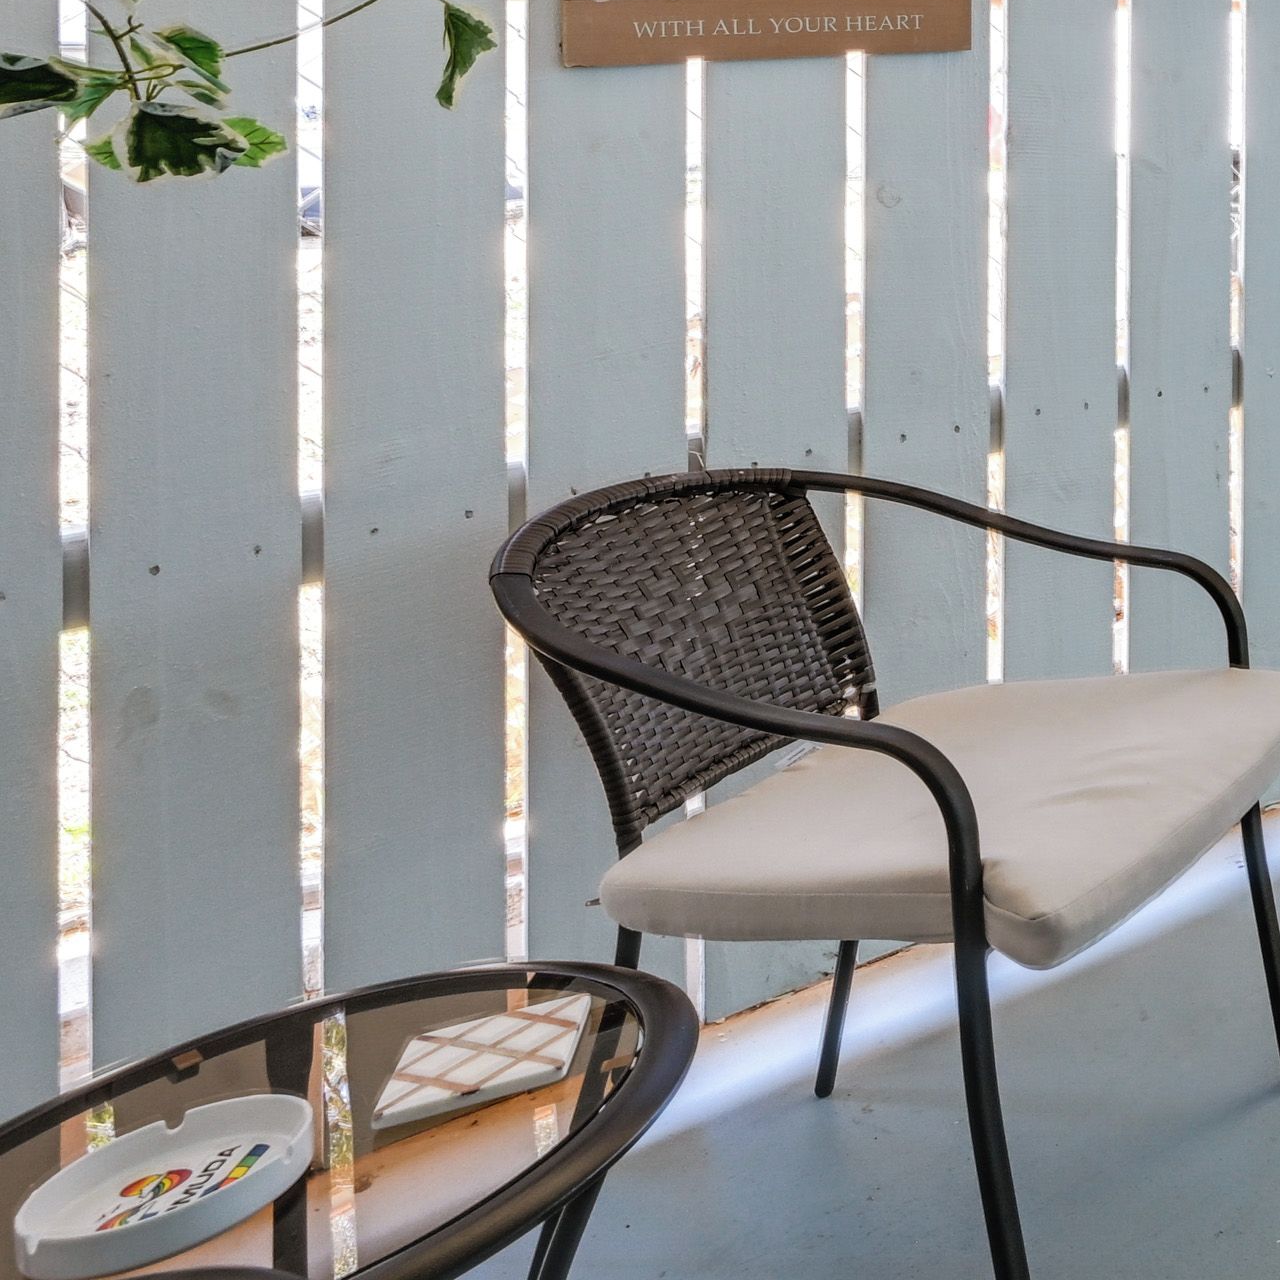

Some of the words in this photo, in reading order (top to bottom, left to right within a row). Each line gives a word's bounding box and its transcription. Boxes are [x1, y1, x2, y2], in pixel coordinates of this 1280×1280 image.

[633, 18, 704, 39] WITH
[712, 17, 762, 37] ALL
[768, 16, 839, 35] YOUR
[845, 13, 925, 33] HEART
[164, 1144, 242, 1213] MUDA
